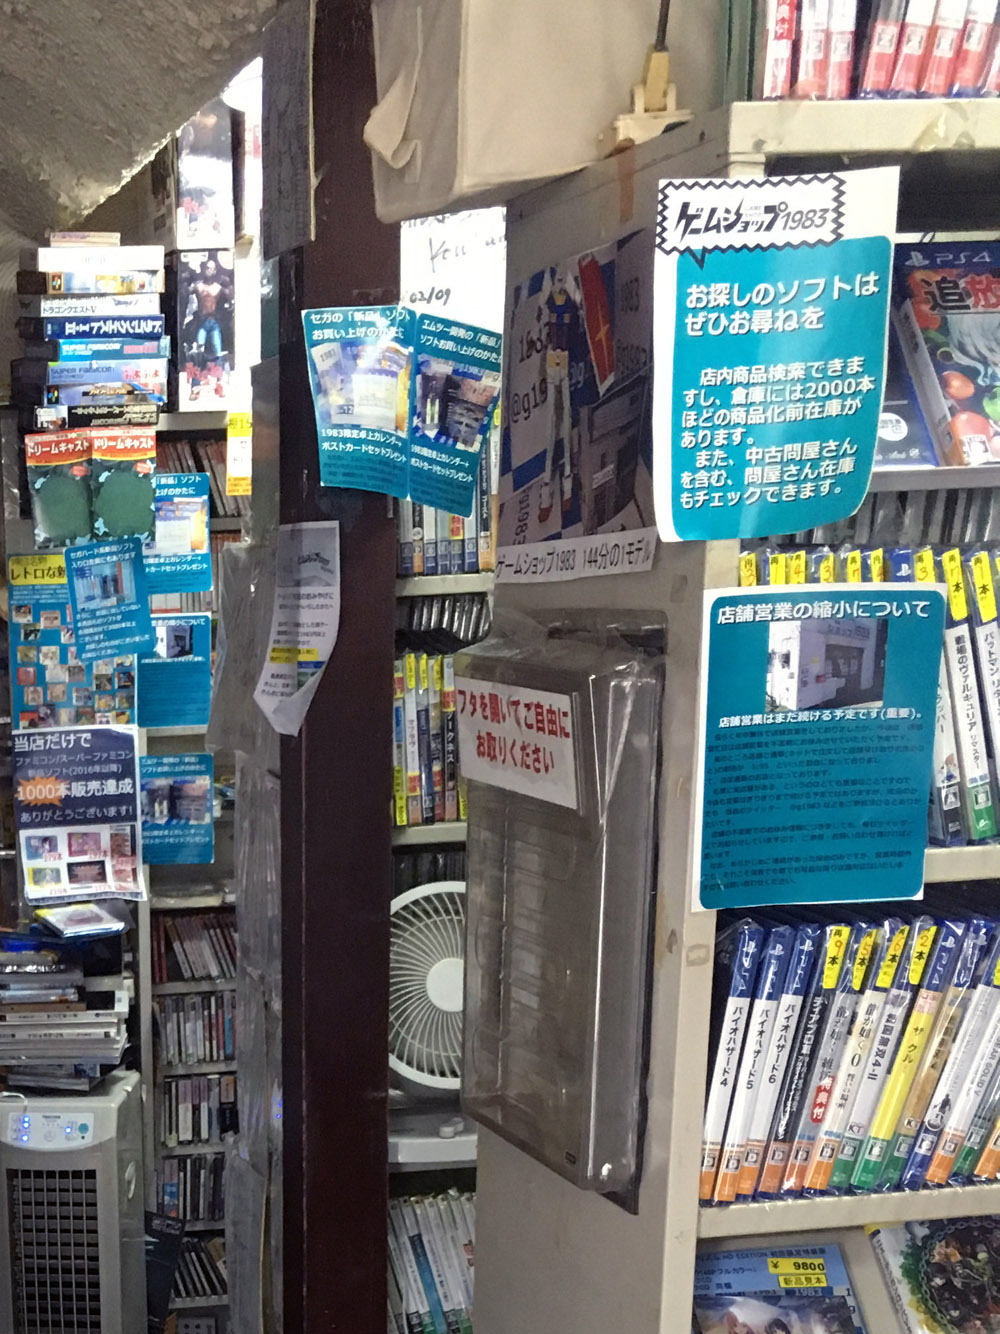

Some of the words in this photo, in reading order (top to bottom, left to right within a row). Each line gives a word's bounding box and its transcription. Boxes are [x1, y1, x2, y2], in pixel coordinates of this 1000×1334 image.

[935, 252, 992, 265] PS4
[686, 271, 880, 309] お探しのソフトは
[685, 306, 825, 336] ぜひお尋ねを
[700, 356, 866, 386] 店内商品検索できま
[683, 376, 876, 408] すし、倉庫には2000本
[682, 396, 862, 428] ほどの商品化前在庫が
[27, 440, 90, 456] ドリームキャスト
[93, 438, 154, 451] ドリームキャスト
[681, 428, 756, 448] あります。
[695, 437, 857, 468] また、中古問屋さん
[681, 457, 855, 489] を含む、問屋さん在庫
[680, 479, 843, 509] もチェックできます。
[717, 599, 931, 625] 店舗営業の縮小について
[458, 689, 570, 738] フタを開いてご自由に
[14, 732, 92, 752] 当店だけで
[476, 729, 554, 774] お取りください
[17, 778, 134, 801] 1000本販売達成
[20, 806, 133, 823] ありがとうございます!
[720, 1006, 743, 1087] バイオハザード4
[746, 1008, 770, 1090] バイオハザード5
[768, 1004, 797, 1084] バイオハザード6
[771, 1260, 780, 1269] ¥
[793, 1261, 825, 1271] 9800
[783, 1277, 825, 1286] 新品見本
